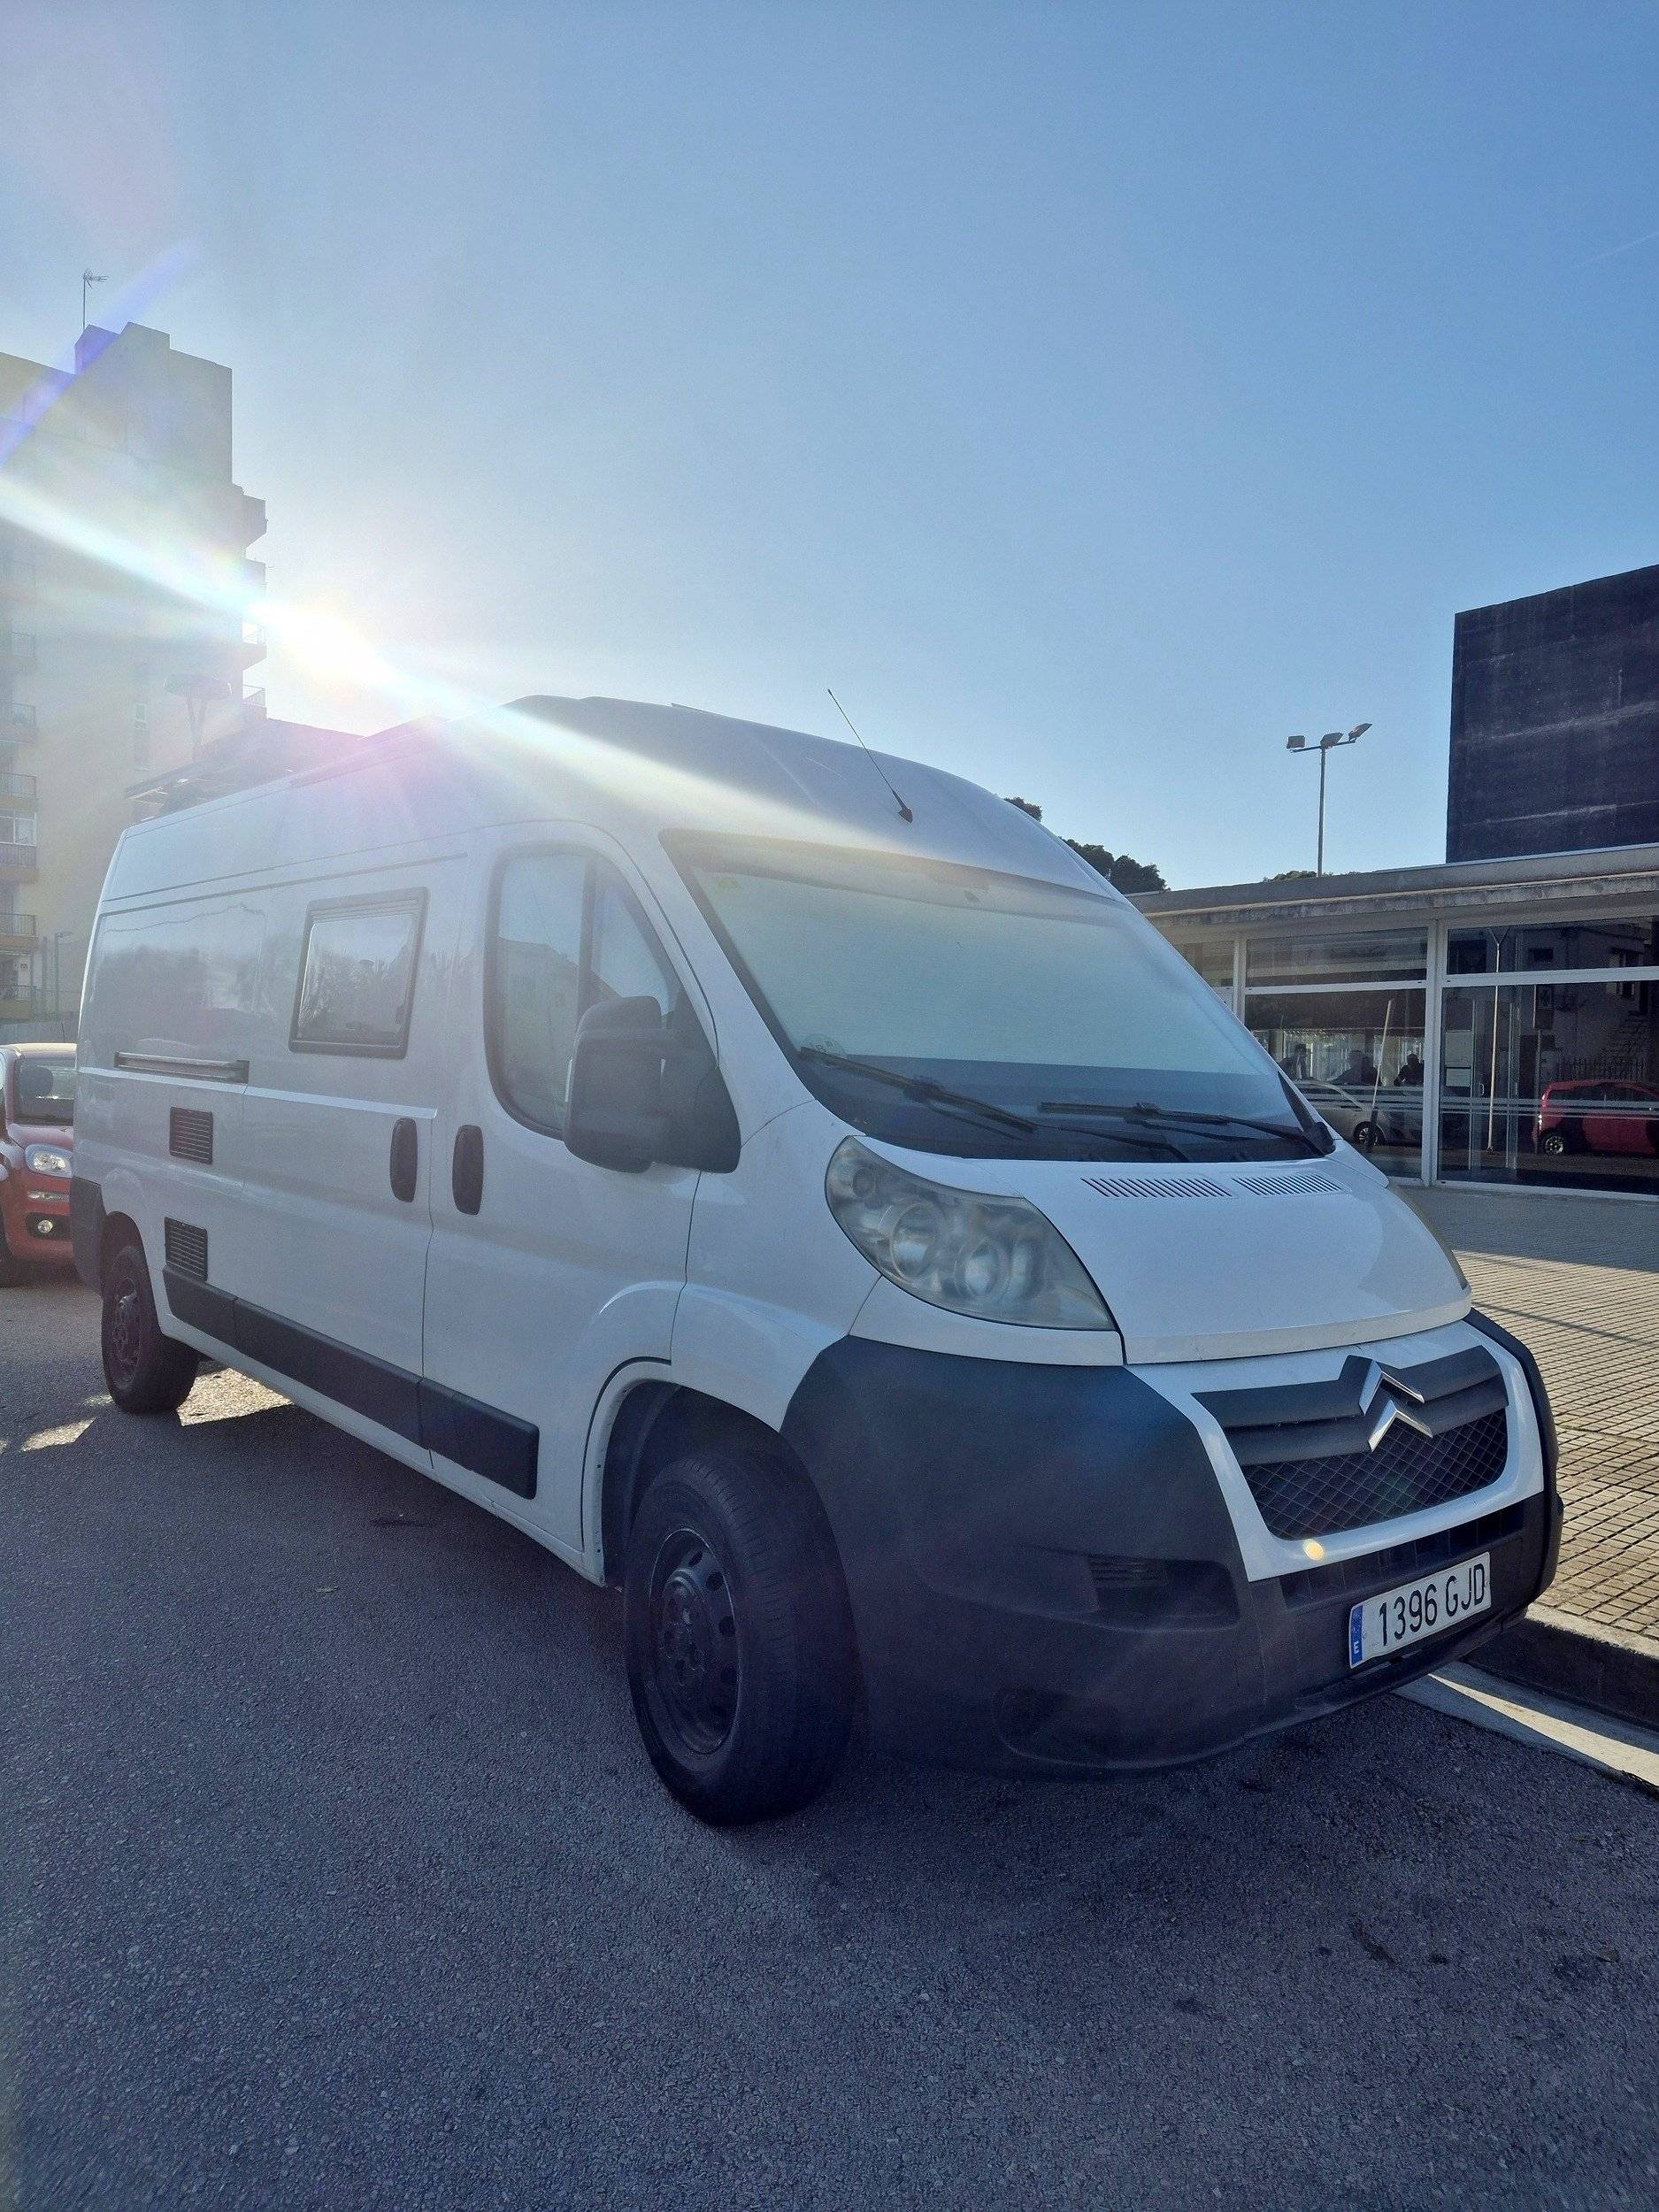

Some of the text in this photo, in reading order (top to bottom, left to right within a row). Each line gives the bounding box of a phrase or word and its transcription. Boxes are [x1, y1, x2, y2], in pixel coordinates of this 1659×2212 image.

[1353, 1563, 1485, 1655] E 1396 GJD
